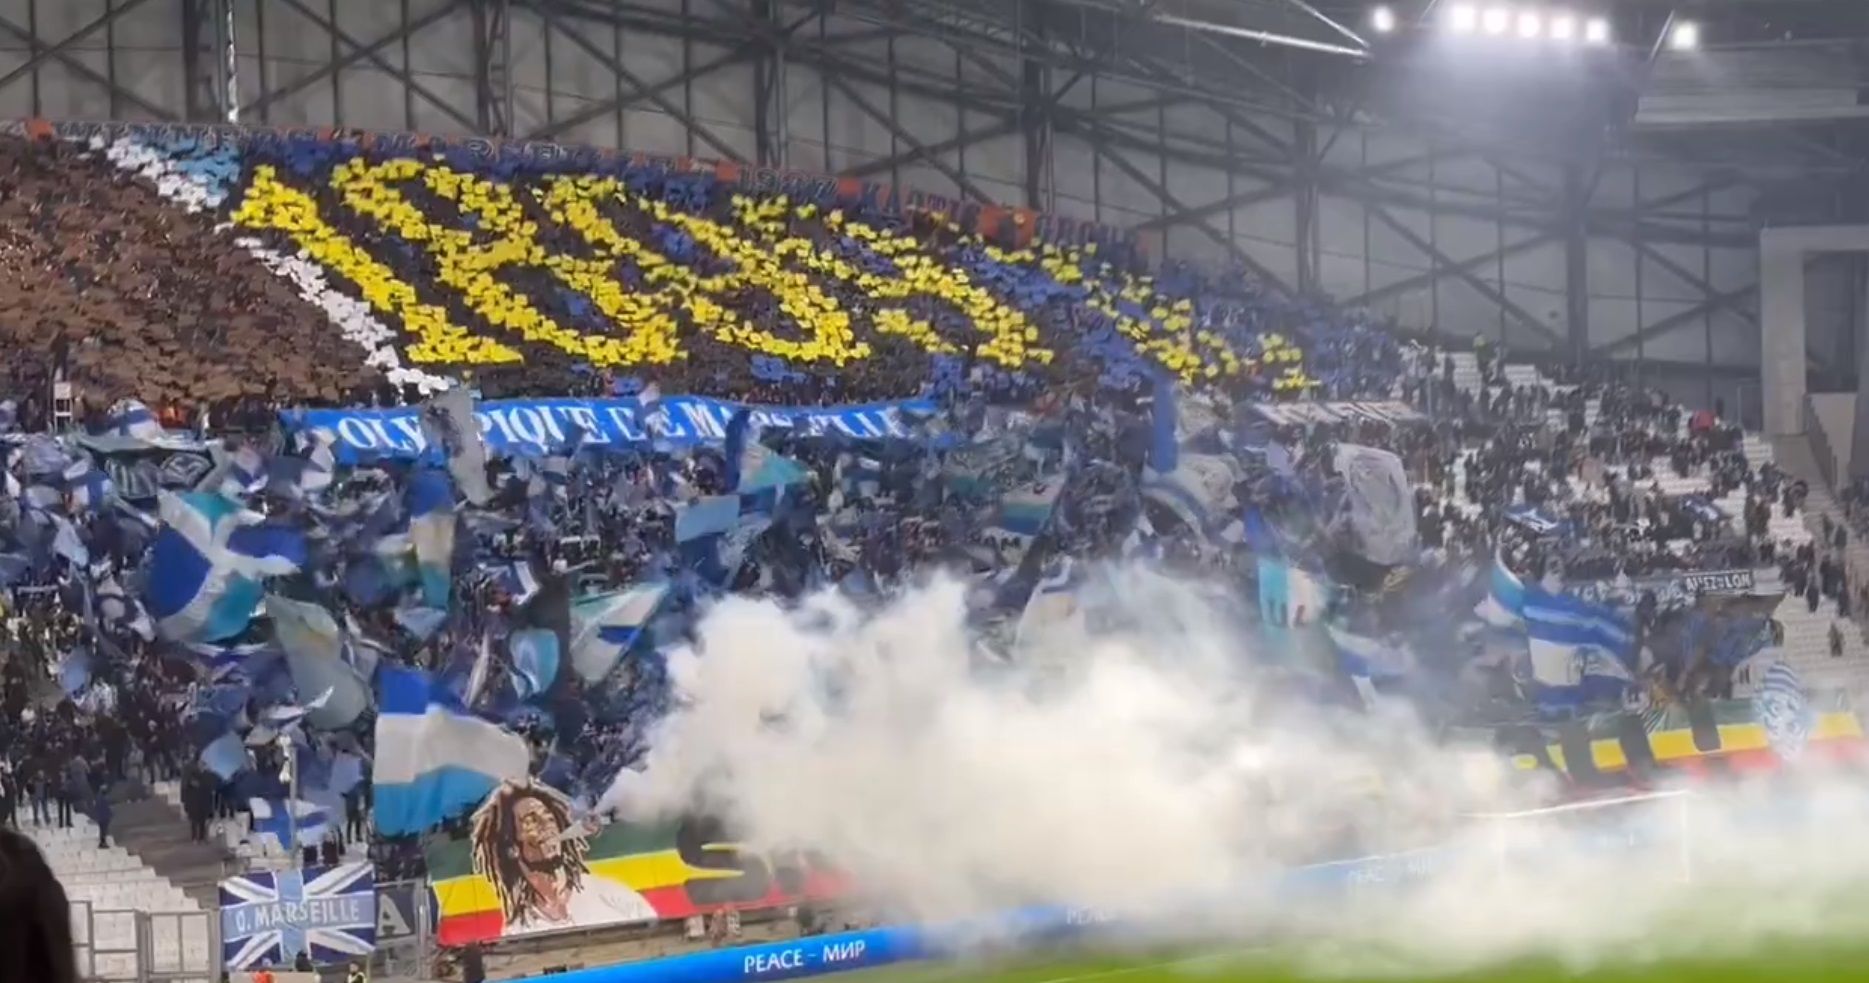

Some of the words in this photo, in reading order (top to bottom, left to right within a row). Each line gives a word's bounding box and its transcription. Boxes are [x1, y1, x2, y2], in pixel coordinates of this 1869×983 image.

[337, 405, 612, 455] OLYPIQUE
[255, 899, 360, 928] MARSEILLE
[744, 949, 804, 973] PEACE
[823, 939, 866, 963] МИР
